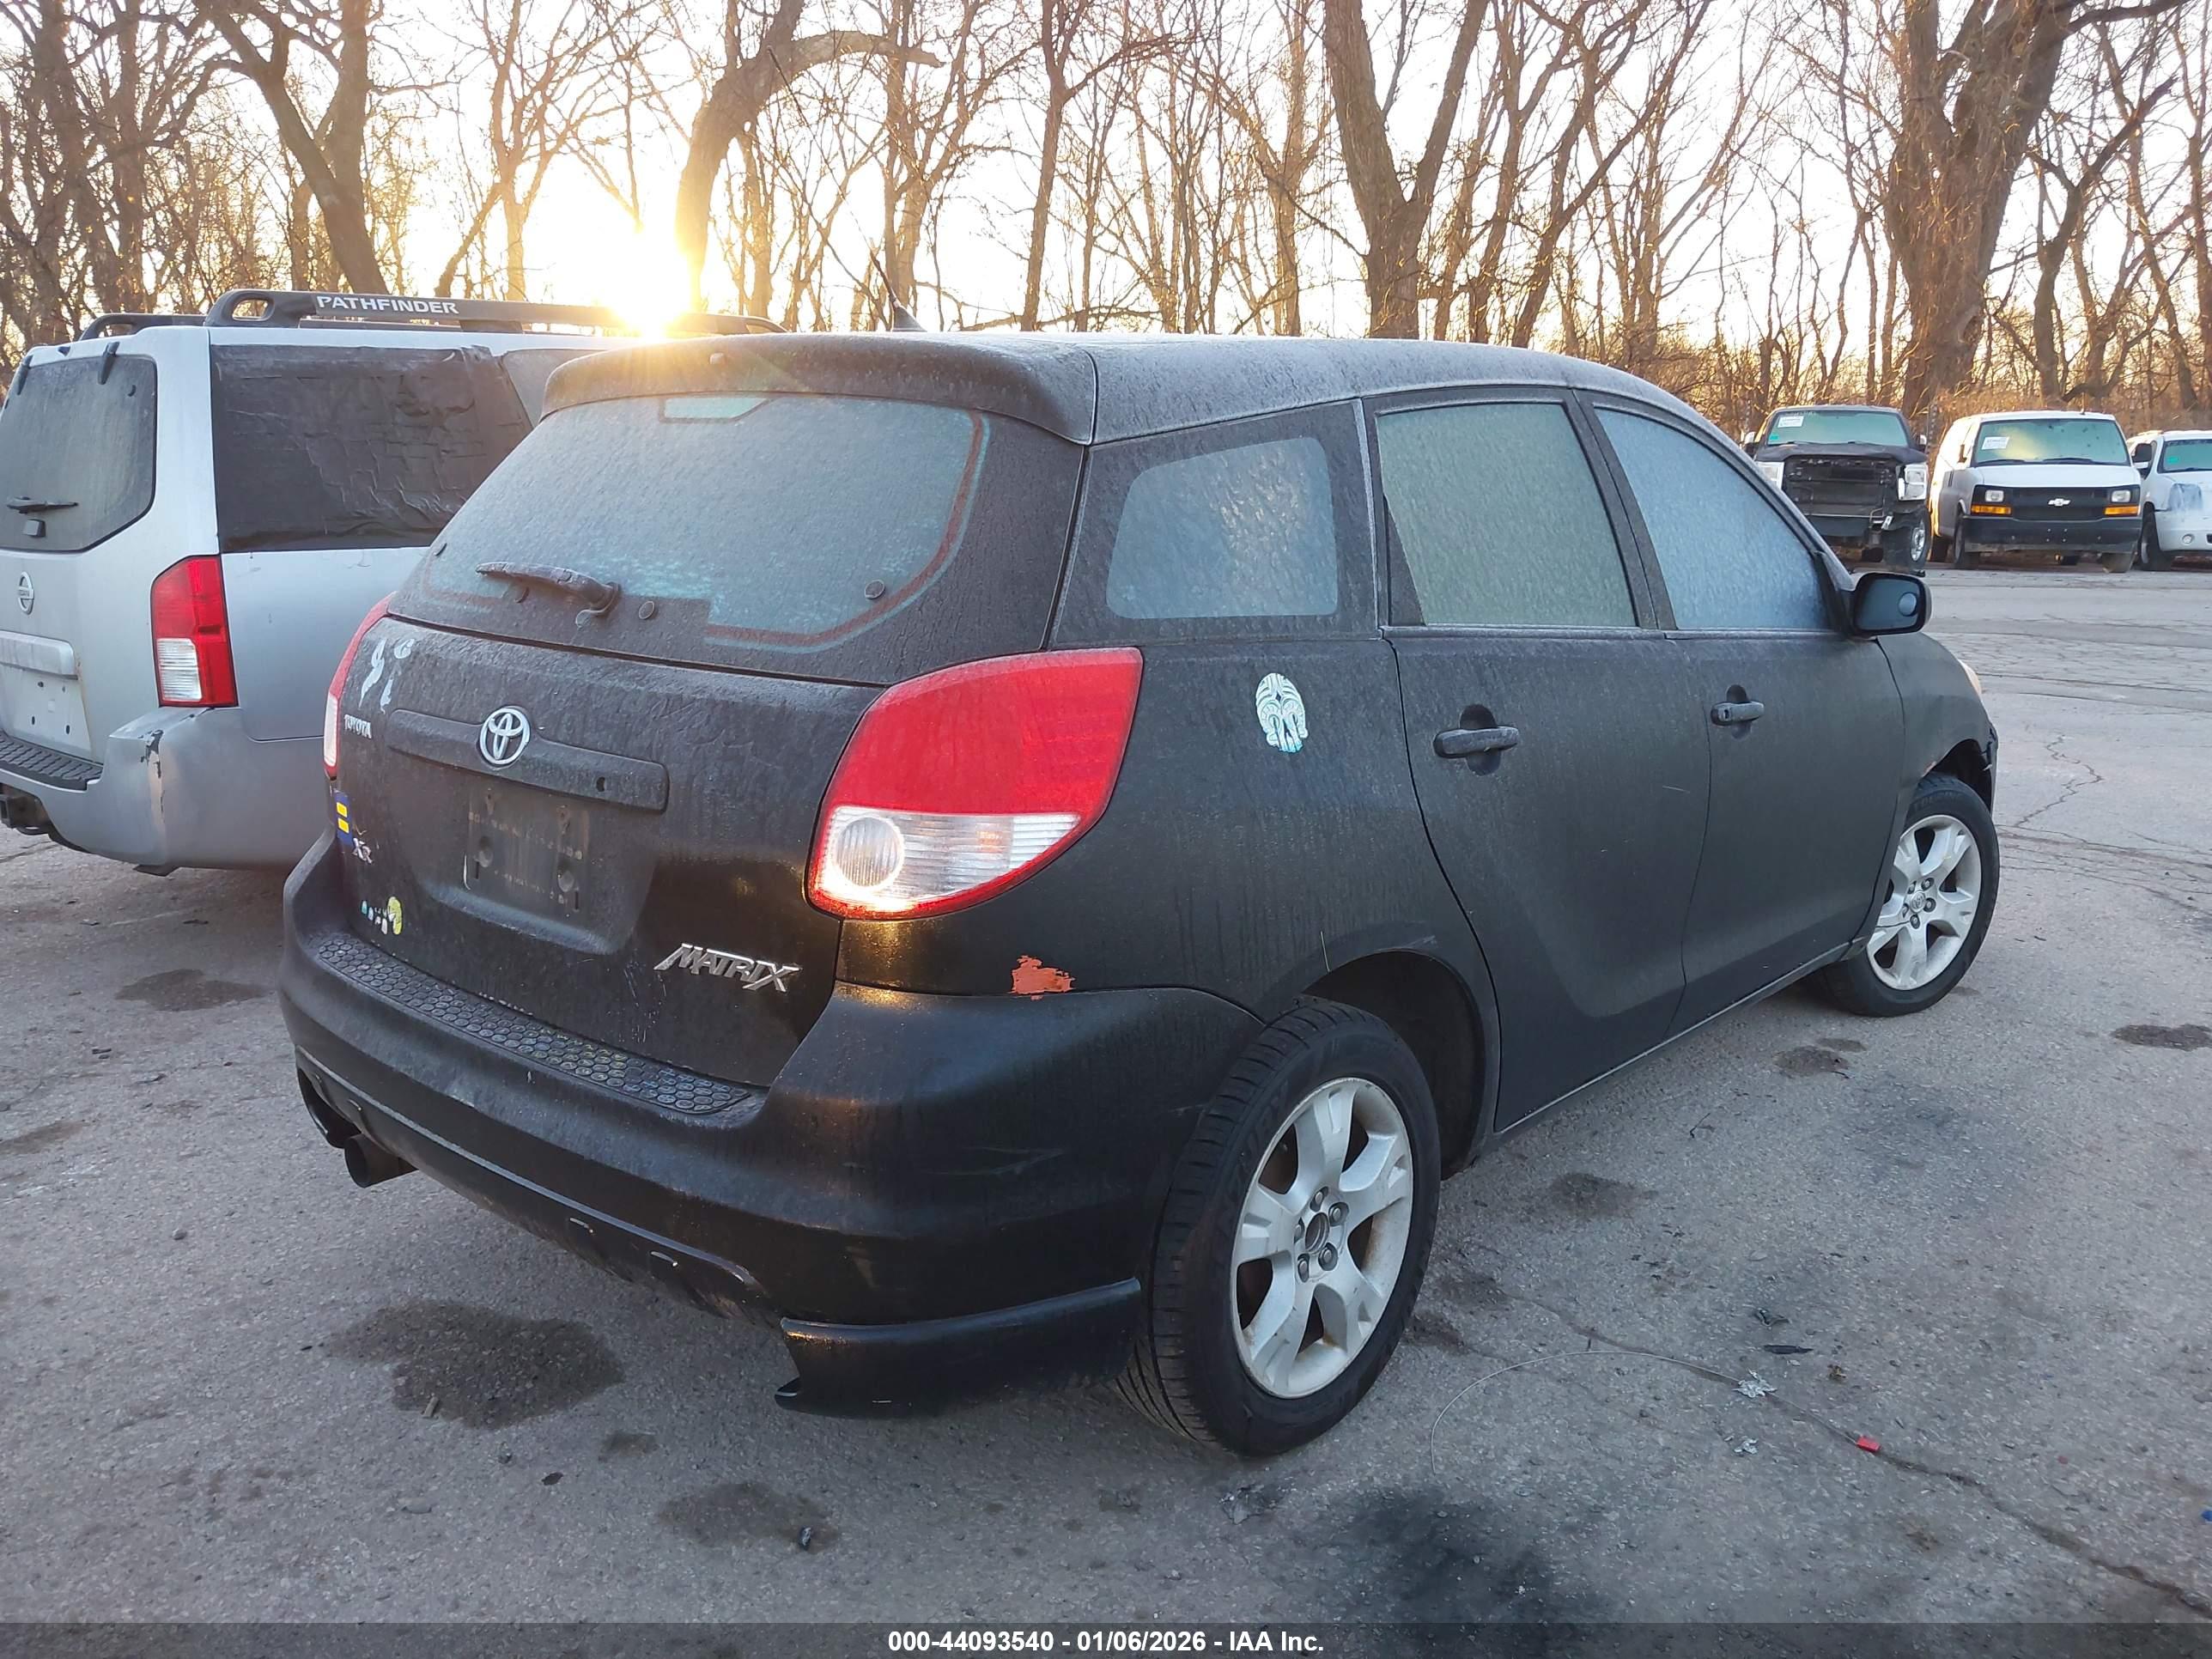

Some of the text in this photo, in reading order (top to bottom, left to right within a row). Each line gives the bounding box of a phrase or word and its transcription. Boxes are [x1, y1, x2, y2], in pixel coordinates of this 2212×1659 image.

[317, 295, 459, 314] PATHFINDER
[343, 714, 372, 739] TOYOTA
[653, 943, 802, 993] MATRIX
